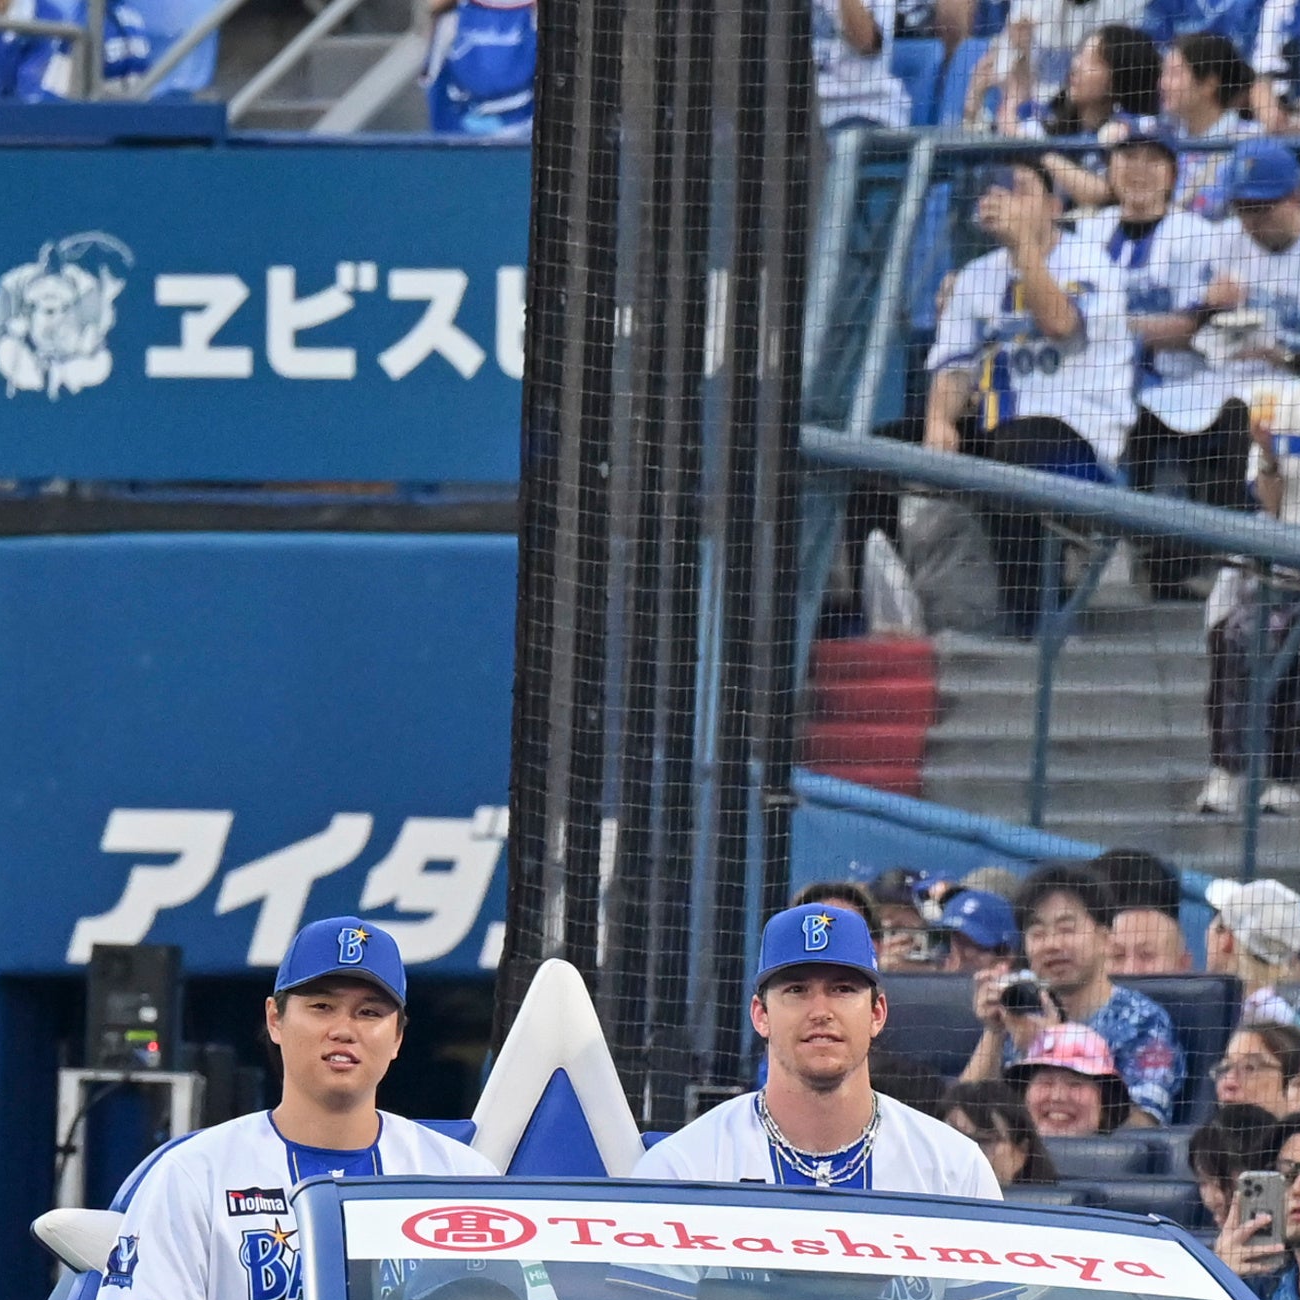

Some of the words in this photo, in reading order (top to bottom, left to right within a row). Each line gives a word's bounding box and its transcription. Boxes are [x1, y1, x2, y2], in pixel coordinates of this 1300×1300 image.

[145, 261, 526, 380] ヱビス
[66, 805, 510, 969] アイダ
[547, 1217, 1166, 1282] Takashimaya
